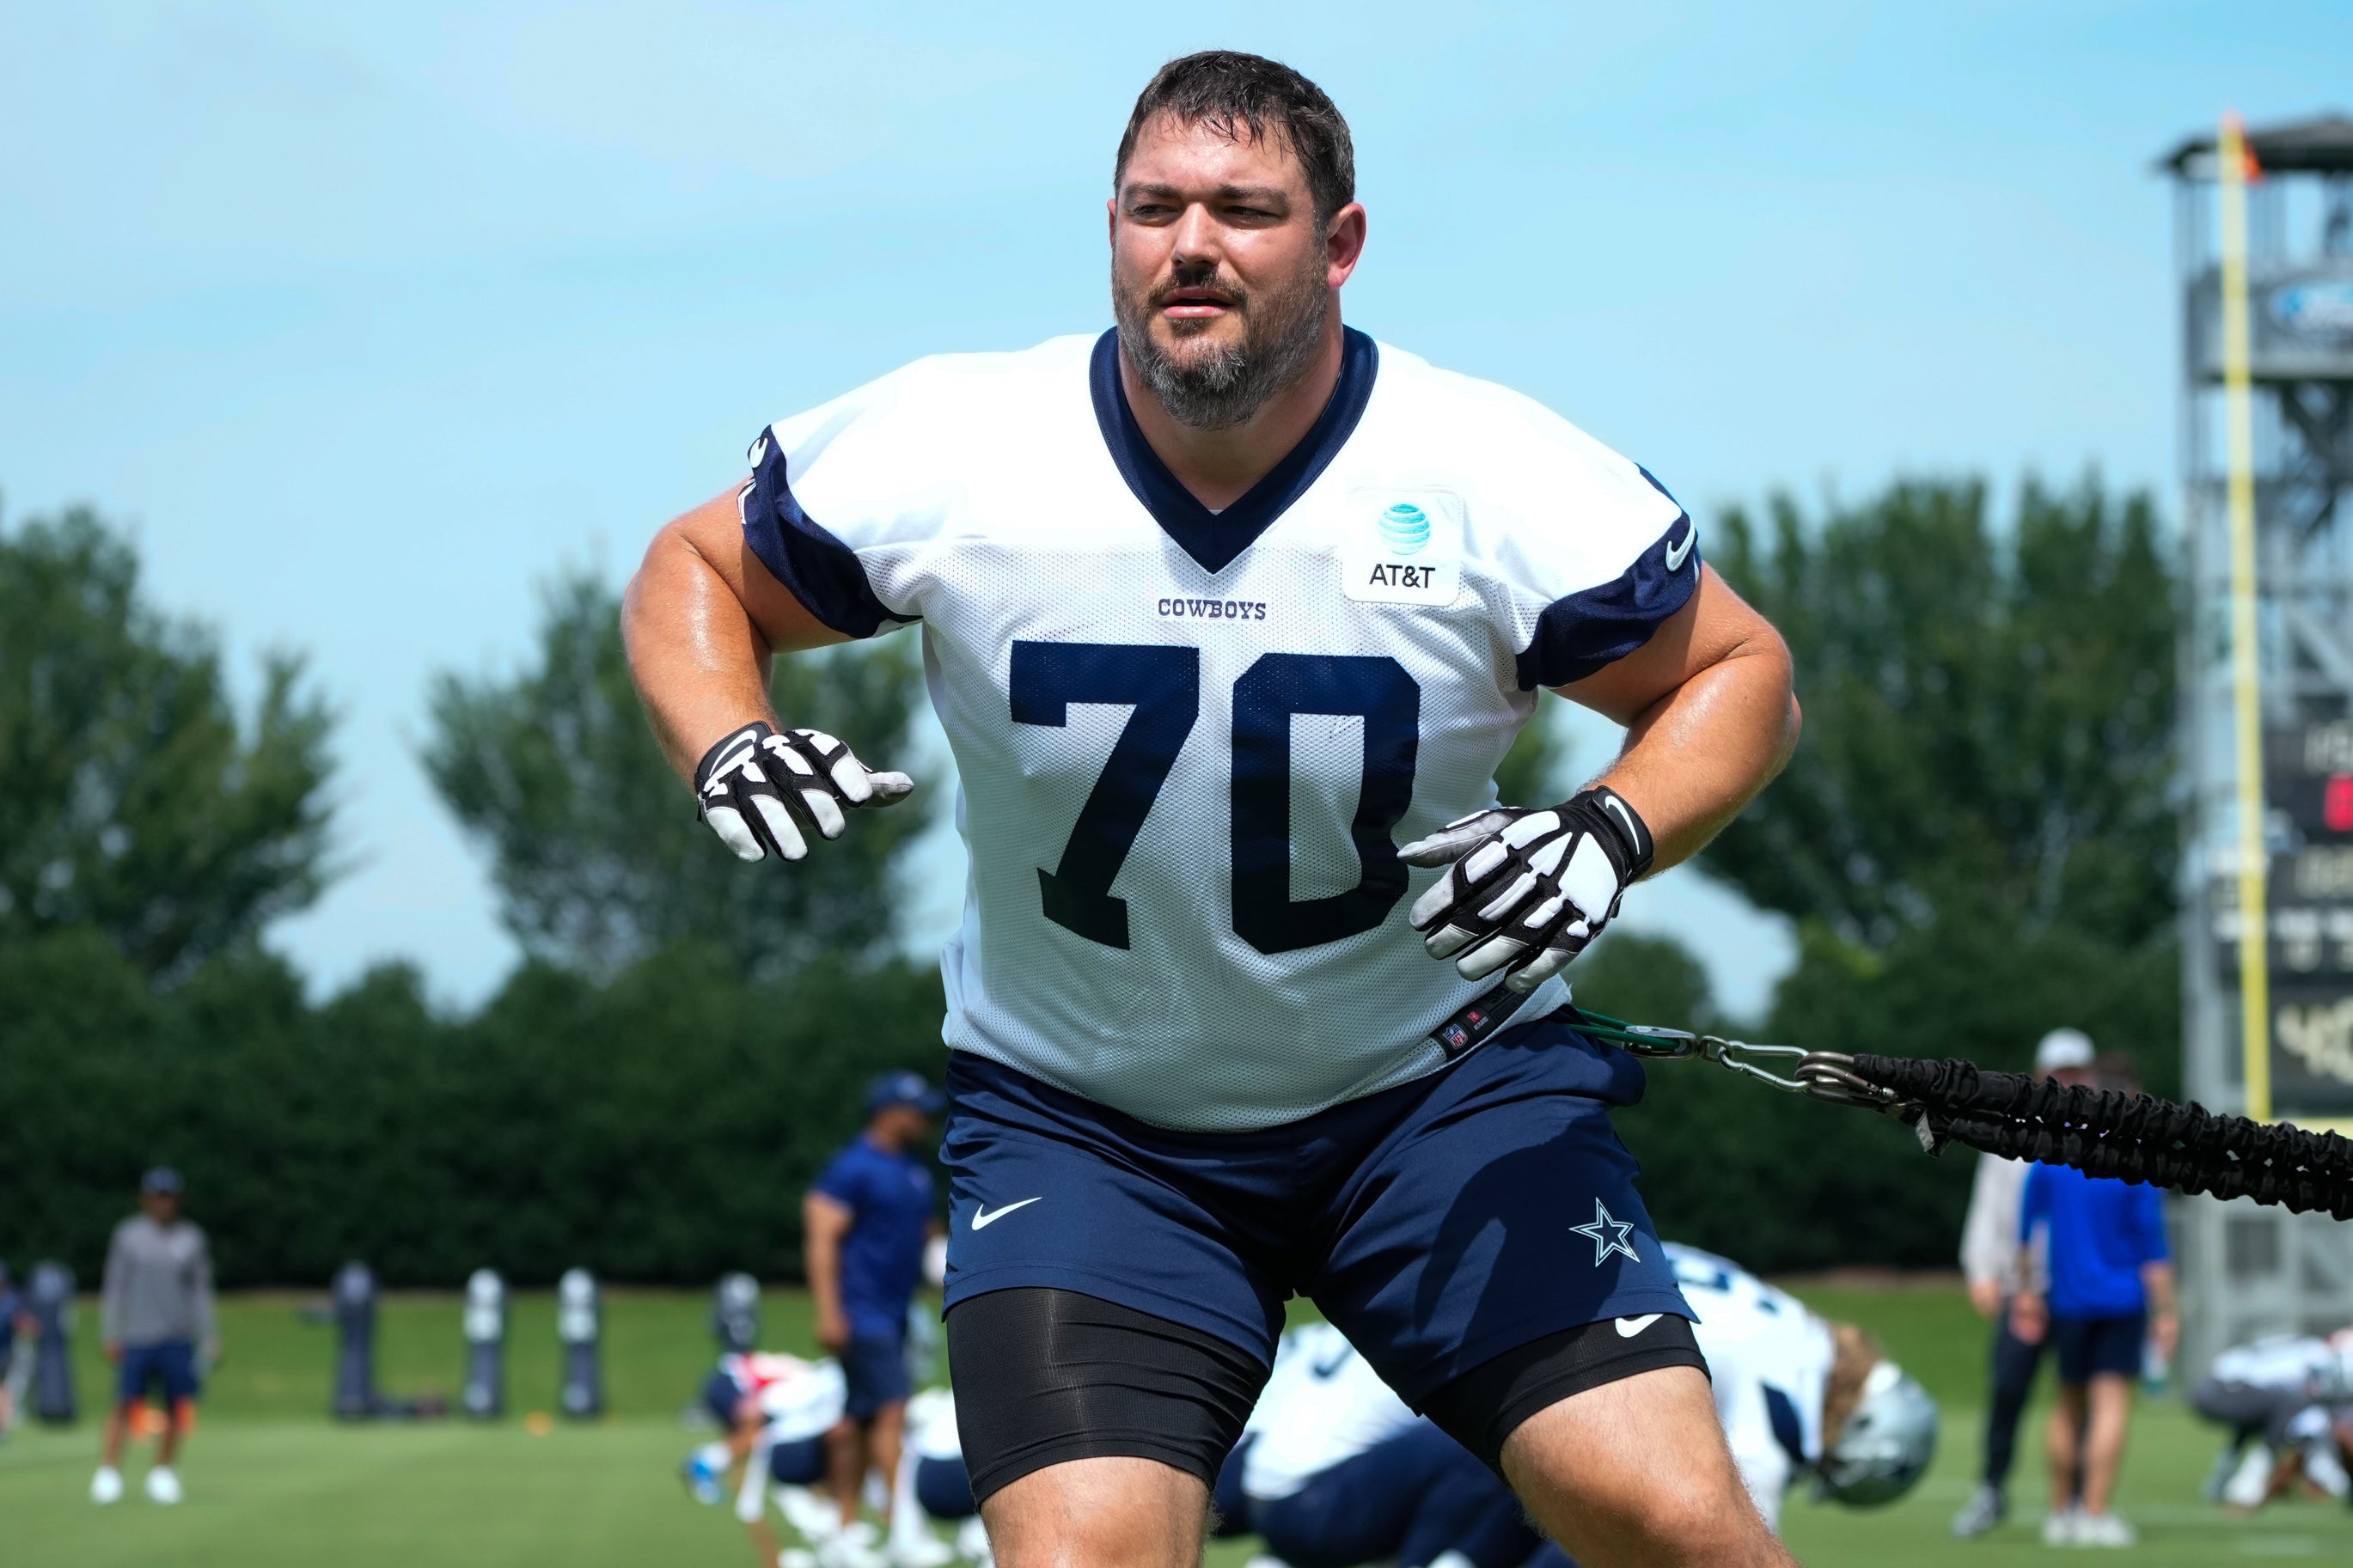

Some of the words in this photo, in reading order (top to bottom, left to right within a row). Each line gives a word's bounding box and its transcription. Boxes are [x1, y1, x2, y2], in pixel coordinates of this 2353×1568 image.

[1369, 564, 1435, 589] AT&T
[1158, 599, 1266, 620] COWBOYS
[1010, 640, 1421, 955] 70
